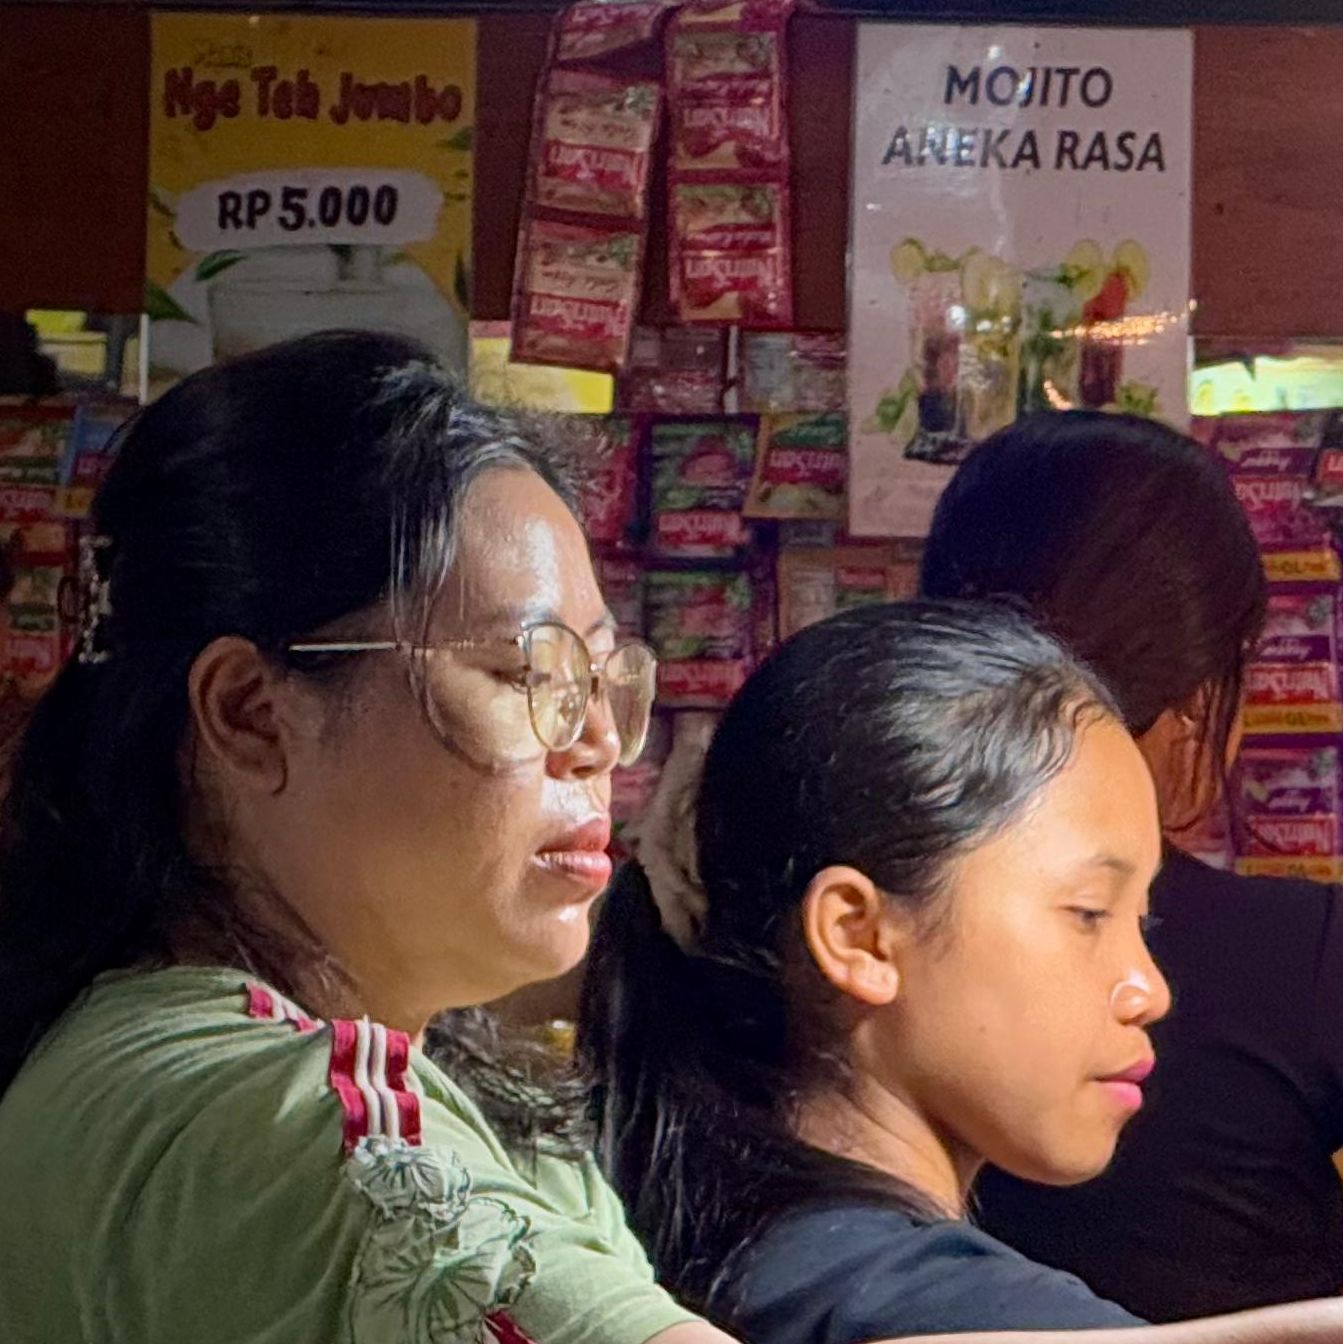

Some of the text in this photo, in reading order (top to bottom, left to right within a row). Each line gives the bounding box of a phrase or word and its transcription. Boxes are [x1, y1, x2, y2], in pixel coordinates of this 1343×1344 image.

[328, 71, 463, 125] Jumbo
[943, 64, 1114, 108] MOJITO
[881, 126, 1168, 173] ANEKA RASA
[218, 184, 398, 231] RP 5.000
